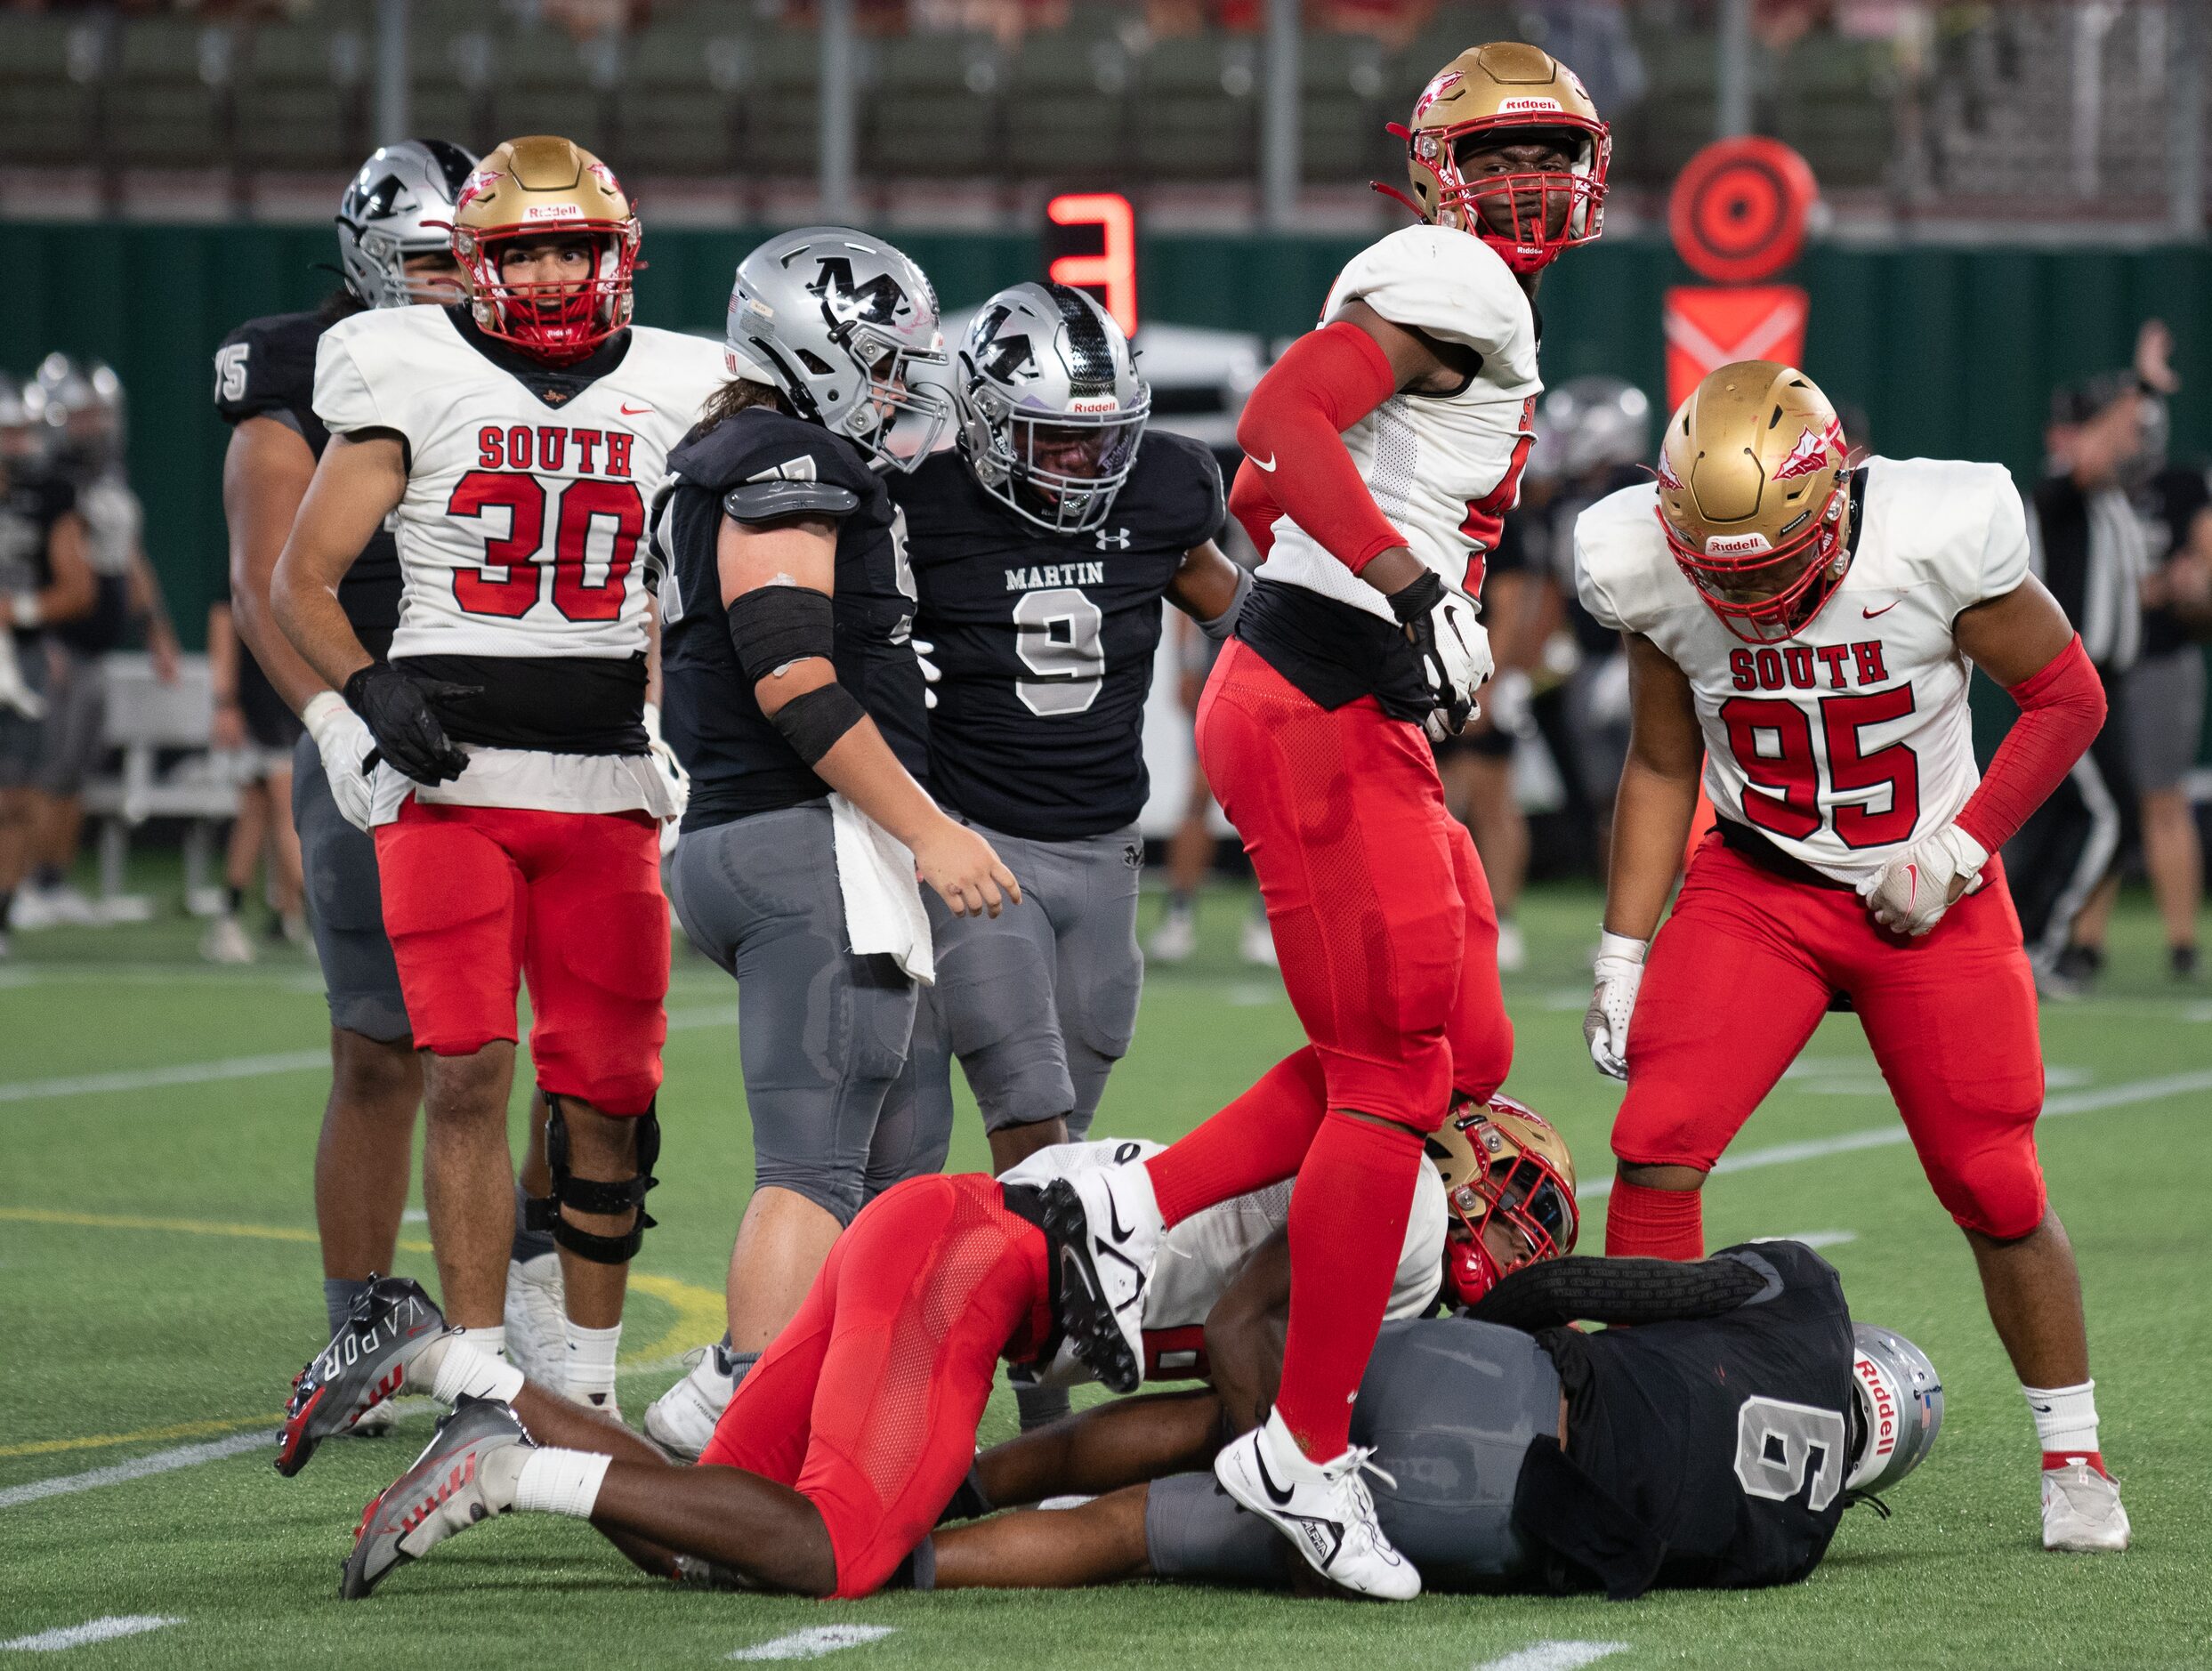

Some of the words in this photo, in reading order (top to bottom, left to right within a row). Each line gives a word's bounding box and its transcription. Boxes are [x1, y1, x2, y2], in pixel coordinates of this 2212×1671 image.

[1047, 193, 1138, 341] 3
[1074, 402, 1116, 413] Riddell
[479, 425, 634, 478] SOUTH
[447, 470, 646, 623] 30
[1005, 561, 1103, 591] MARTIN
[1711, 537, 1760, 552] Riddell
[1012, 587, 1105, 717] 9
[1729, 640, 1889, 691] SOUTH
[1718, 680, 1921, 851] 95
[323, 1295, 425, 1382] VAPOR
[1854, 1360, 1895, 1457] Riddell
[1300, 1519, 1328, 1559] ALPHA
